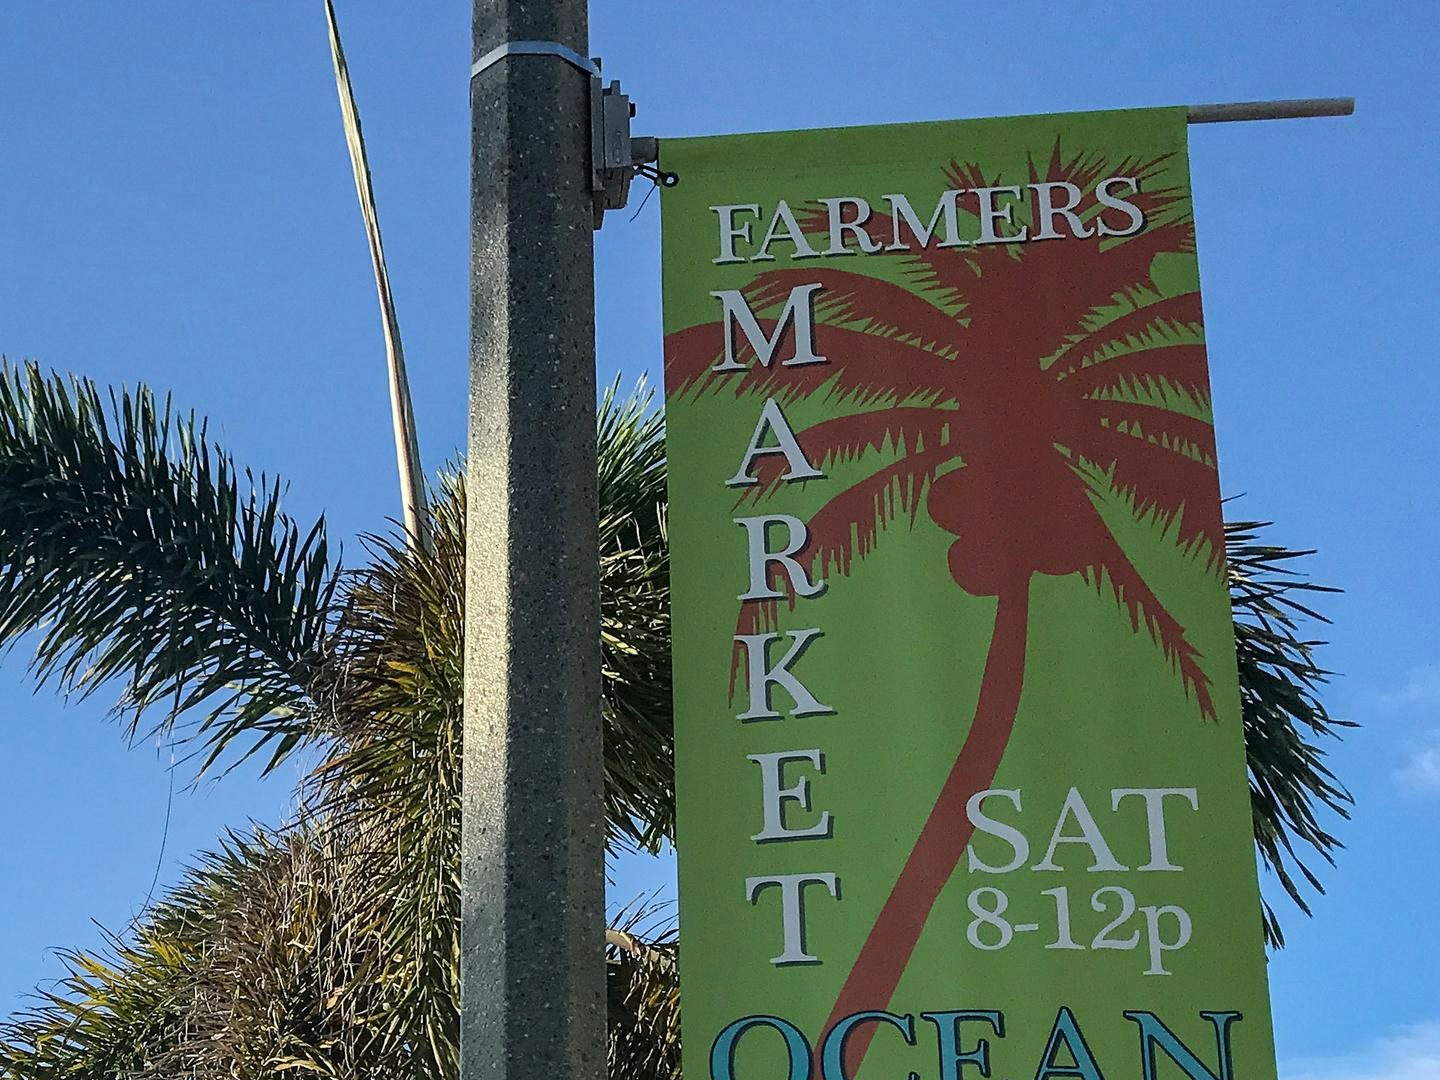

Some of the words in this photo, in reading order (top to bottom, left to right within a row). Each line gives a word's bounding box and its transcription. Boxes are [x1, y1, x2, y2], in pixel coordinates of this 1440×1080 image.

[709, 176, 1145, 264] FARMERS
[710, 281, 841, 968] MARKET
[965, 785, 1199, 875] SAT
[966, 885, 1192, 976] 8-12p
